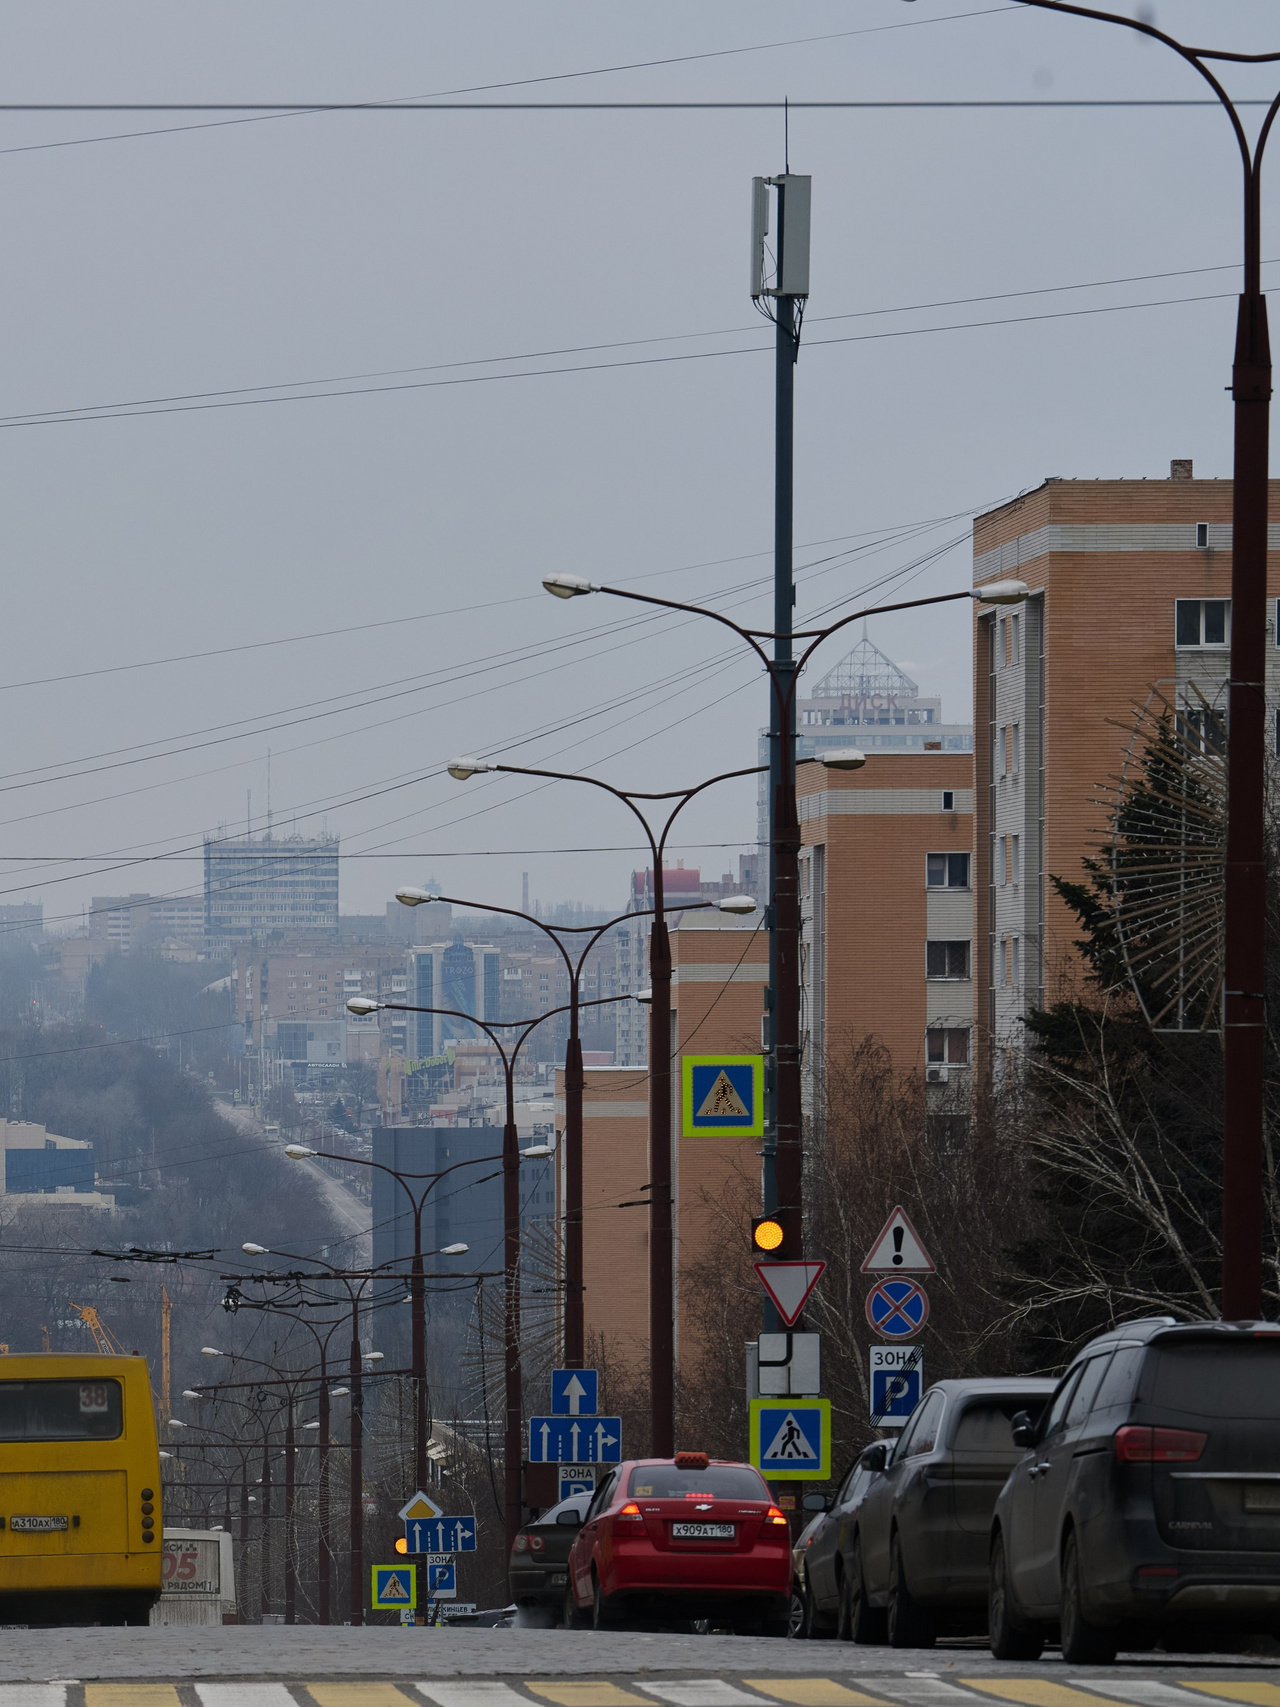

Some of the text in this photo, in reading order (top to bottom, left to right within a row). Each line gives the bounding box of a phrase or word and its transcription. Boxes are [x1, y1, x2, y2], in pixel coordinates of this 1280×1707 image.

[840, 693, 900, 711] ДИСК
[874, 1351, 918, 1366] ЗОНА
[81, 1386, 106, 1407] 38
[561, 1468, 593, 1479] ЗОНА
[676, 1525, 732, 1536] Х909АТ 180
[429, 1556, 454, 1564] ЗОНА
[168, 1581, 204, 1590] РЯДОМ
